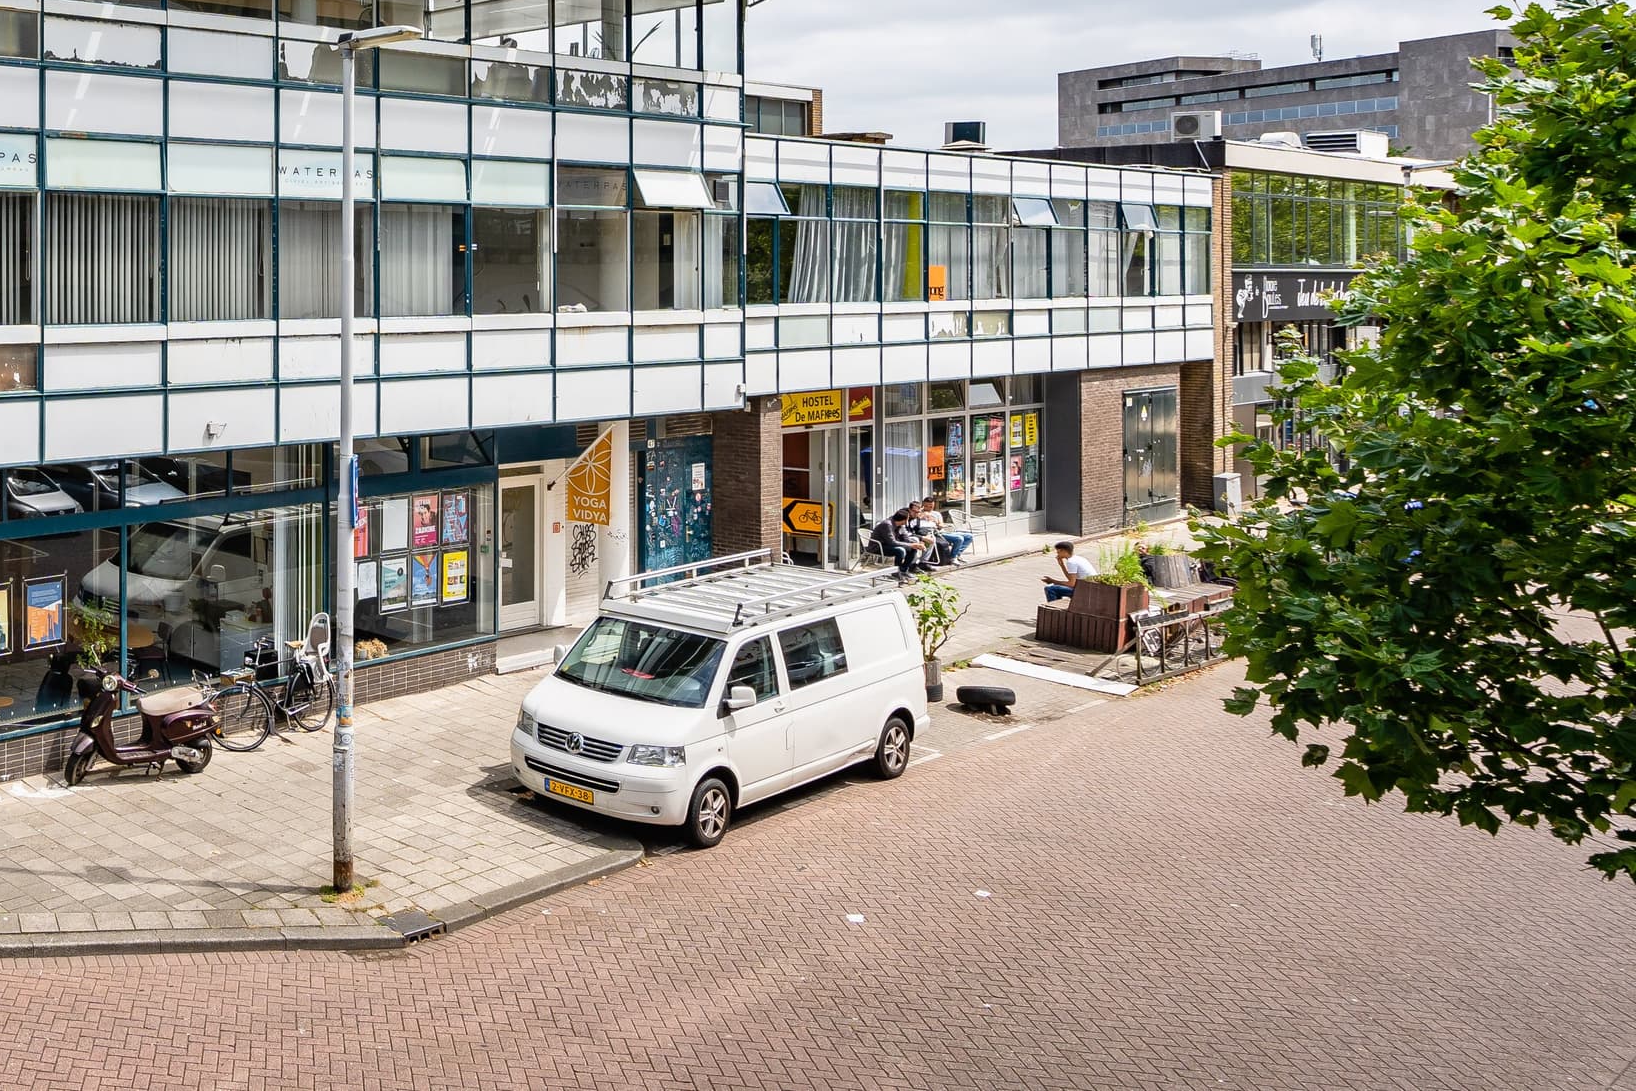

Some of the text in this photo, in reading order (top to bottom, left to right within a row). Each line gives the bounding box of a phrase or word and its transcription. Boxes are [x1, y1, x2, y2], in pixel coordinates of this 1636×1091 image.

[278, 165, 373, 179] WATERAS
[802, 395, 834, 408] HOSTEL
[795, 411, 806, 423] De
[573, 495, 607, 510] YOGA
[572, 508, 608, 523] VIDYA
